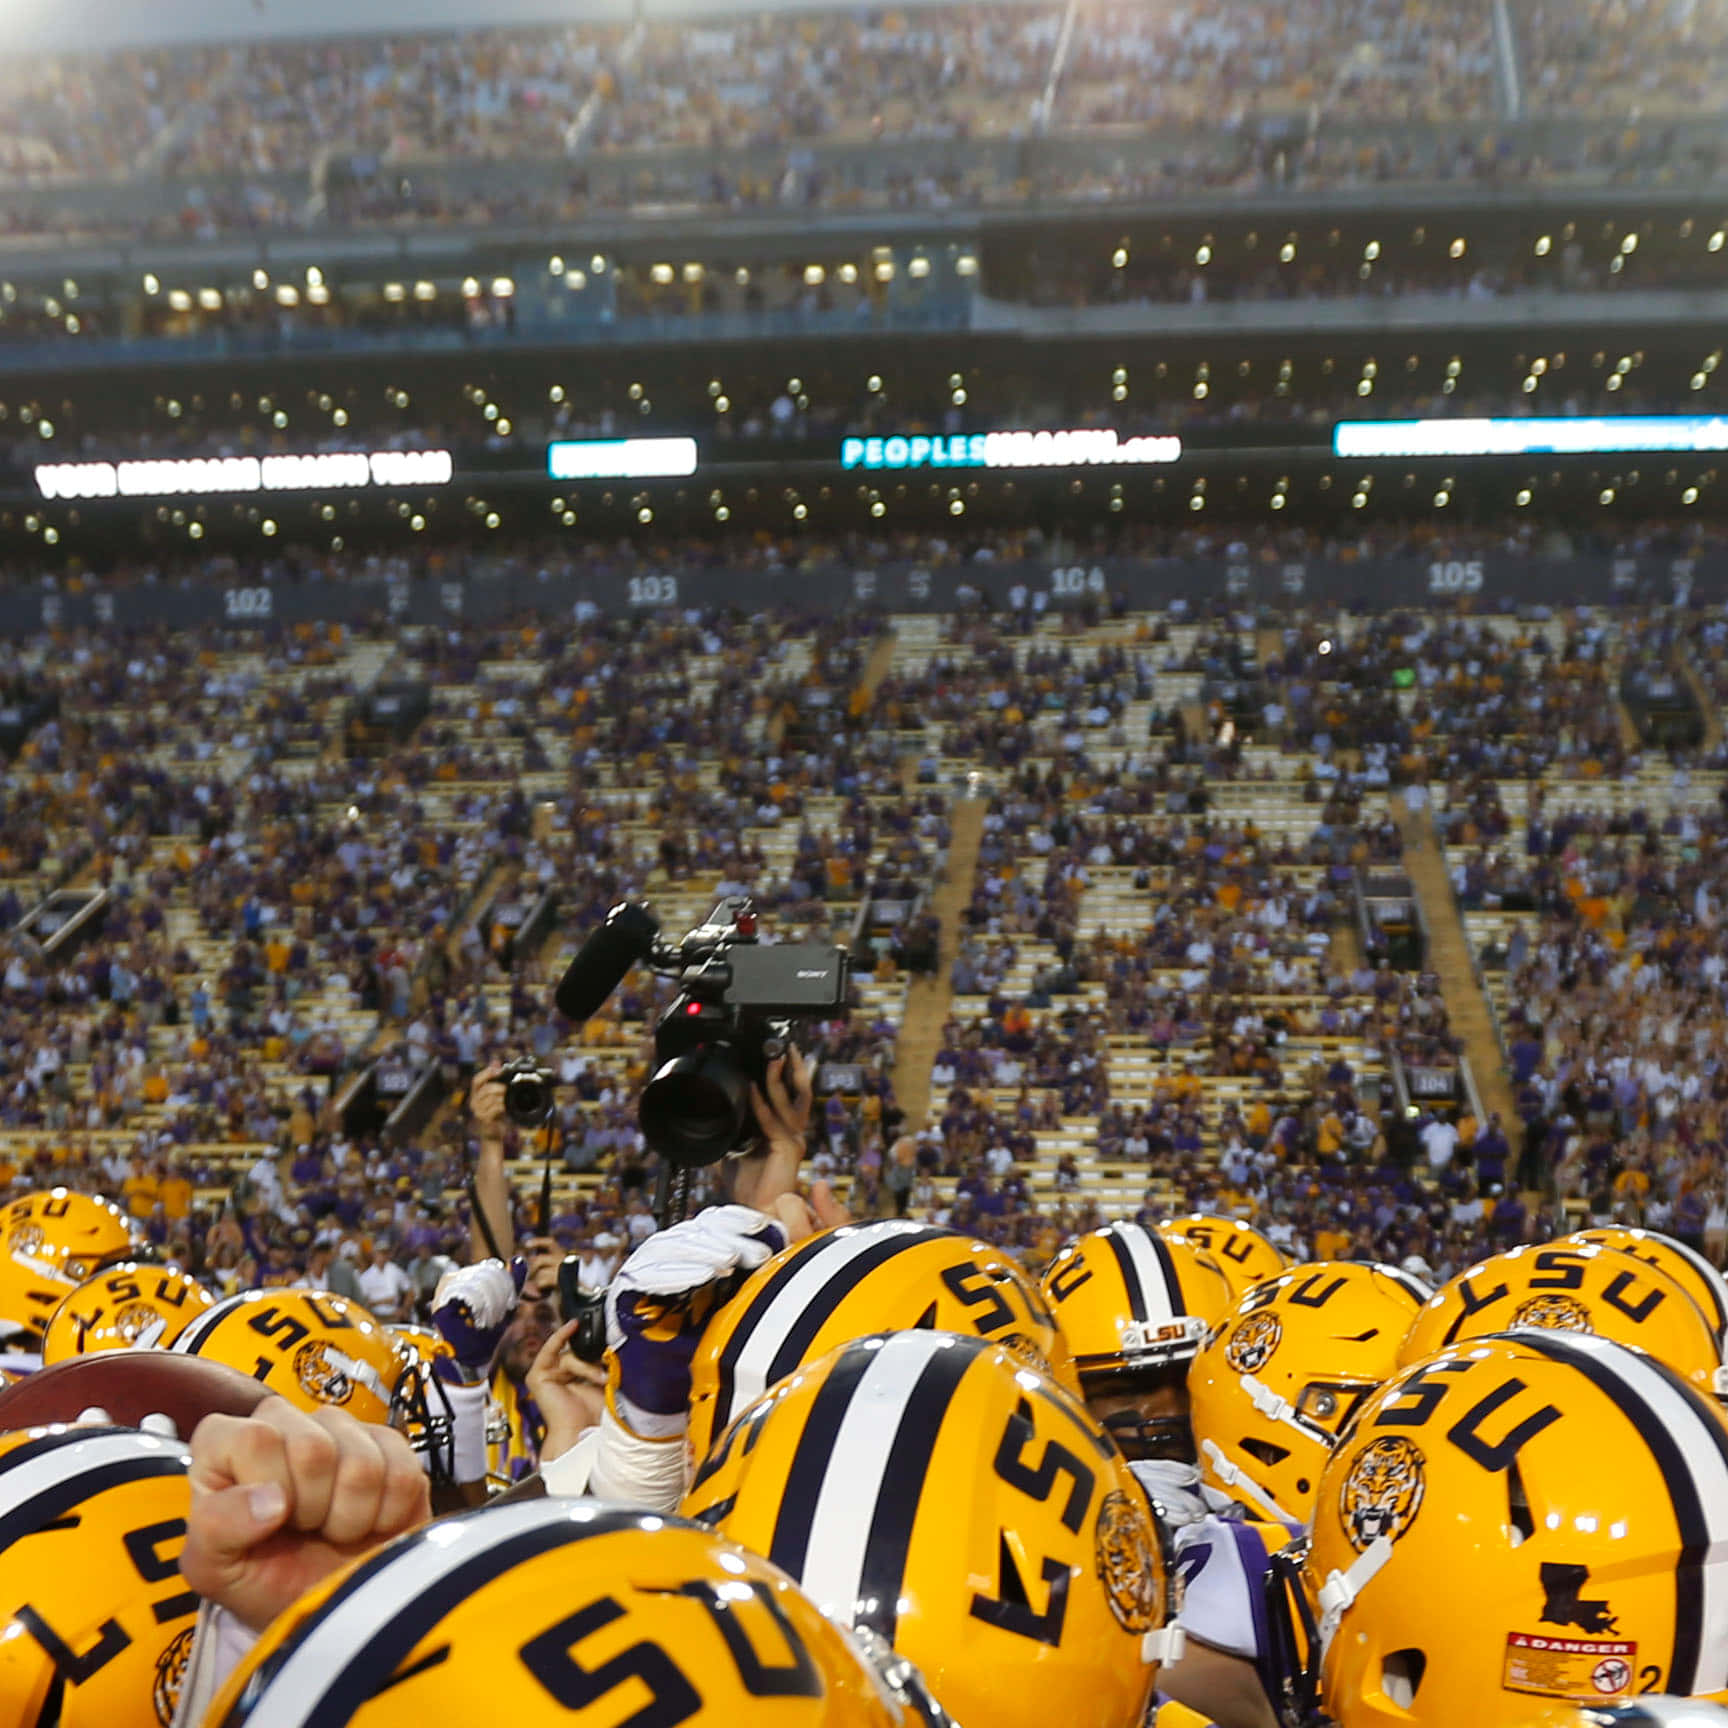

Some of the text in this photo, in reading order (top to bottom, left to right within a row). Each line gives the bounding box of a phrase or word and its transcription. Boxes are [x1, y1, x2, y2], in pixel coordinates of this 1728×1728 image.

[1428, 562, 1485, 590] 105
[627, 577, 677, 606] 103
[70, 1274, 189, 1332] LSU
[1459, 1252, 1666, 1324] LSU
[1143, 1323, 1186, 1345] LSU
[1376, 1360, 1565, 1473] SU
[971, 1384, 1122, 1648] LS
[1531, 1638, 1629, 1654] DANGER
[1639, 1665, 1662, 1695] 2
